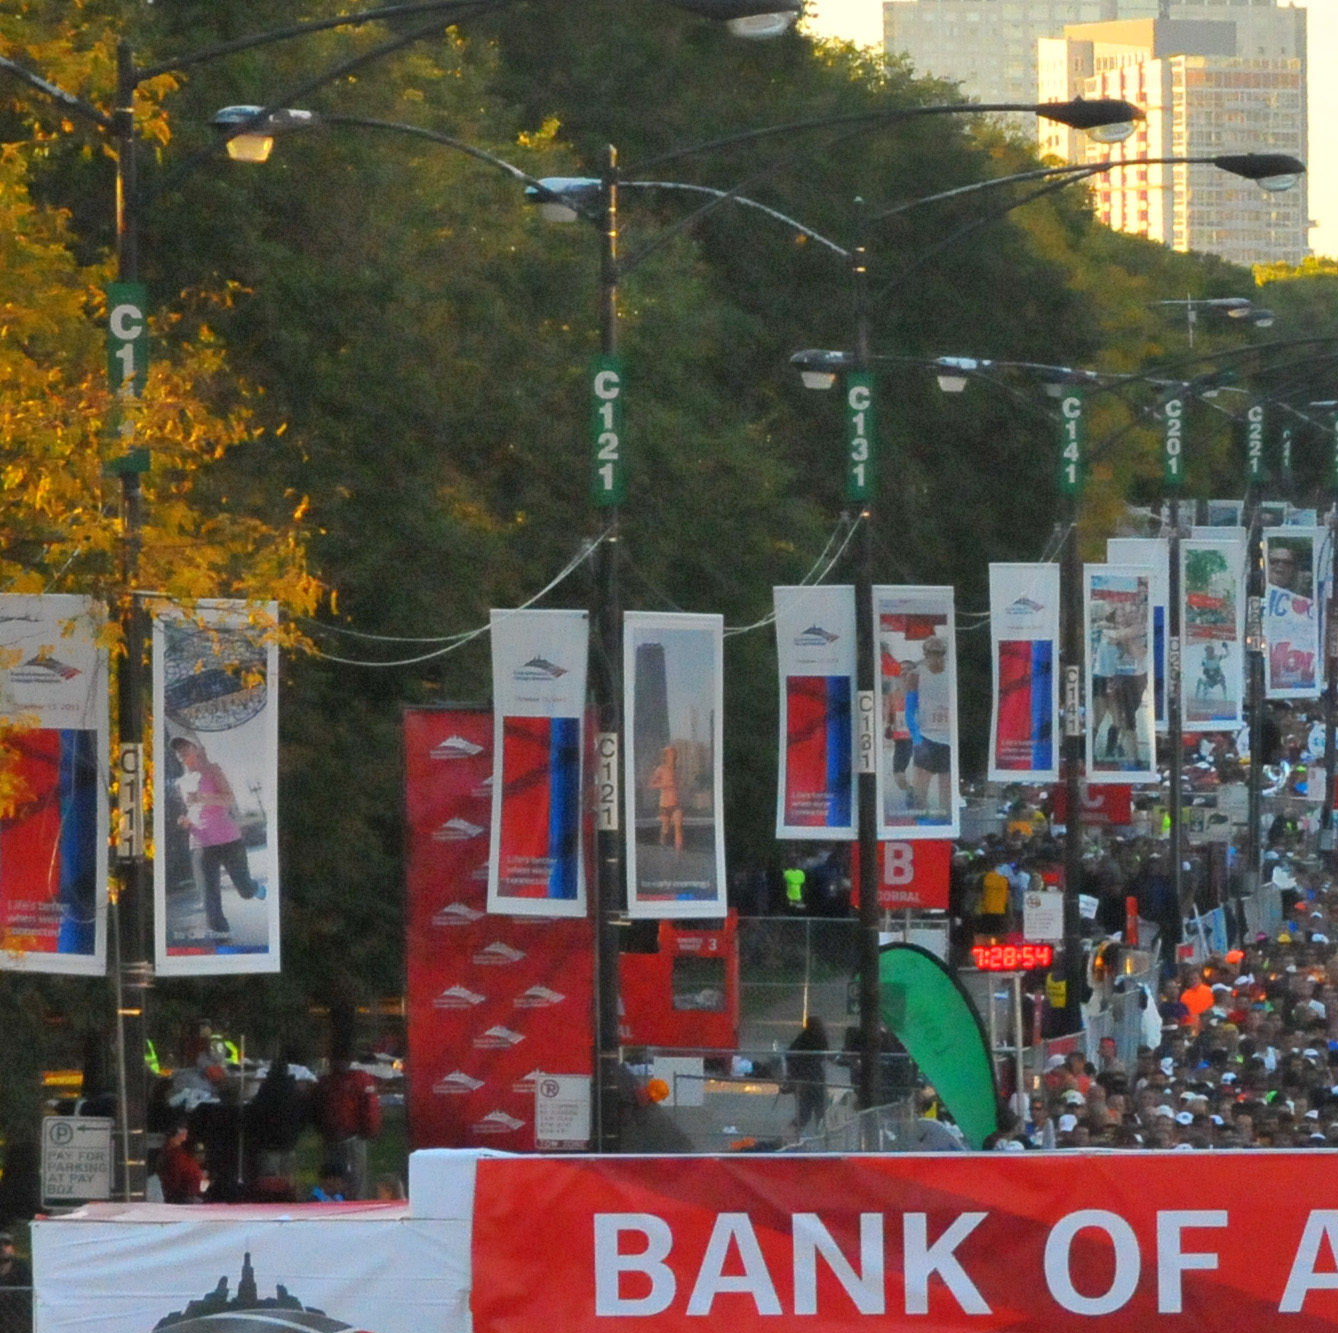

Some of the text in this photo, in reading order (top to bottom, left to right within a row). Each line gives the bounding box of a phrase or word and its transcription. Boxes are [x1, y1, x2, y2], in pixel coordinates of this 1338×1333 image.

[593, 370, 621, 492] C121
[847, 385, 871, 487] C131
[1062, 397, 1081, 484] C141
[1164, 399, 1182, 475] C201
[1247, 405, 1263, 473] C221
[858, 694, 874, 770] C131
[1067, 670, 1080, 733] C141
[119, 749, 140, 857] C111
[600, 737, 616, 827] C121
[884, 841, 915, 886] B
[7, 898, 38, 911] Life's
[47, 1152, 105, 1161] PAY FOR
[47, 1163, 108, 1173] PARKING
[47, 1184, 73, 1194] BOX
[70, 1174, 94, 1183] PAY
[594, 1212, 991, 1316] BANK
[1044, 1209, 1228, 1314] OF
